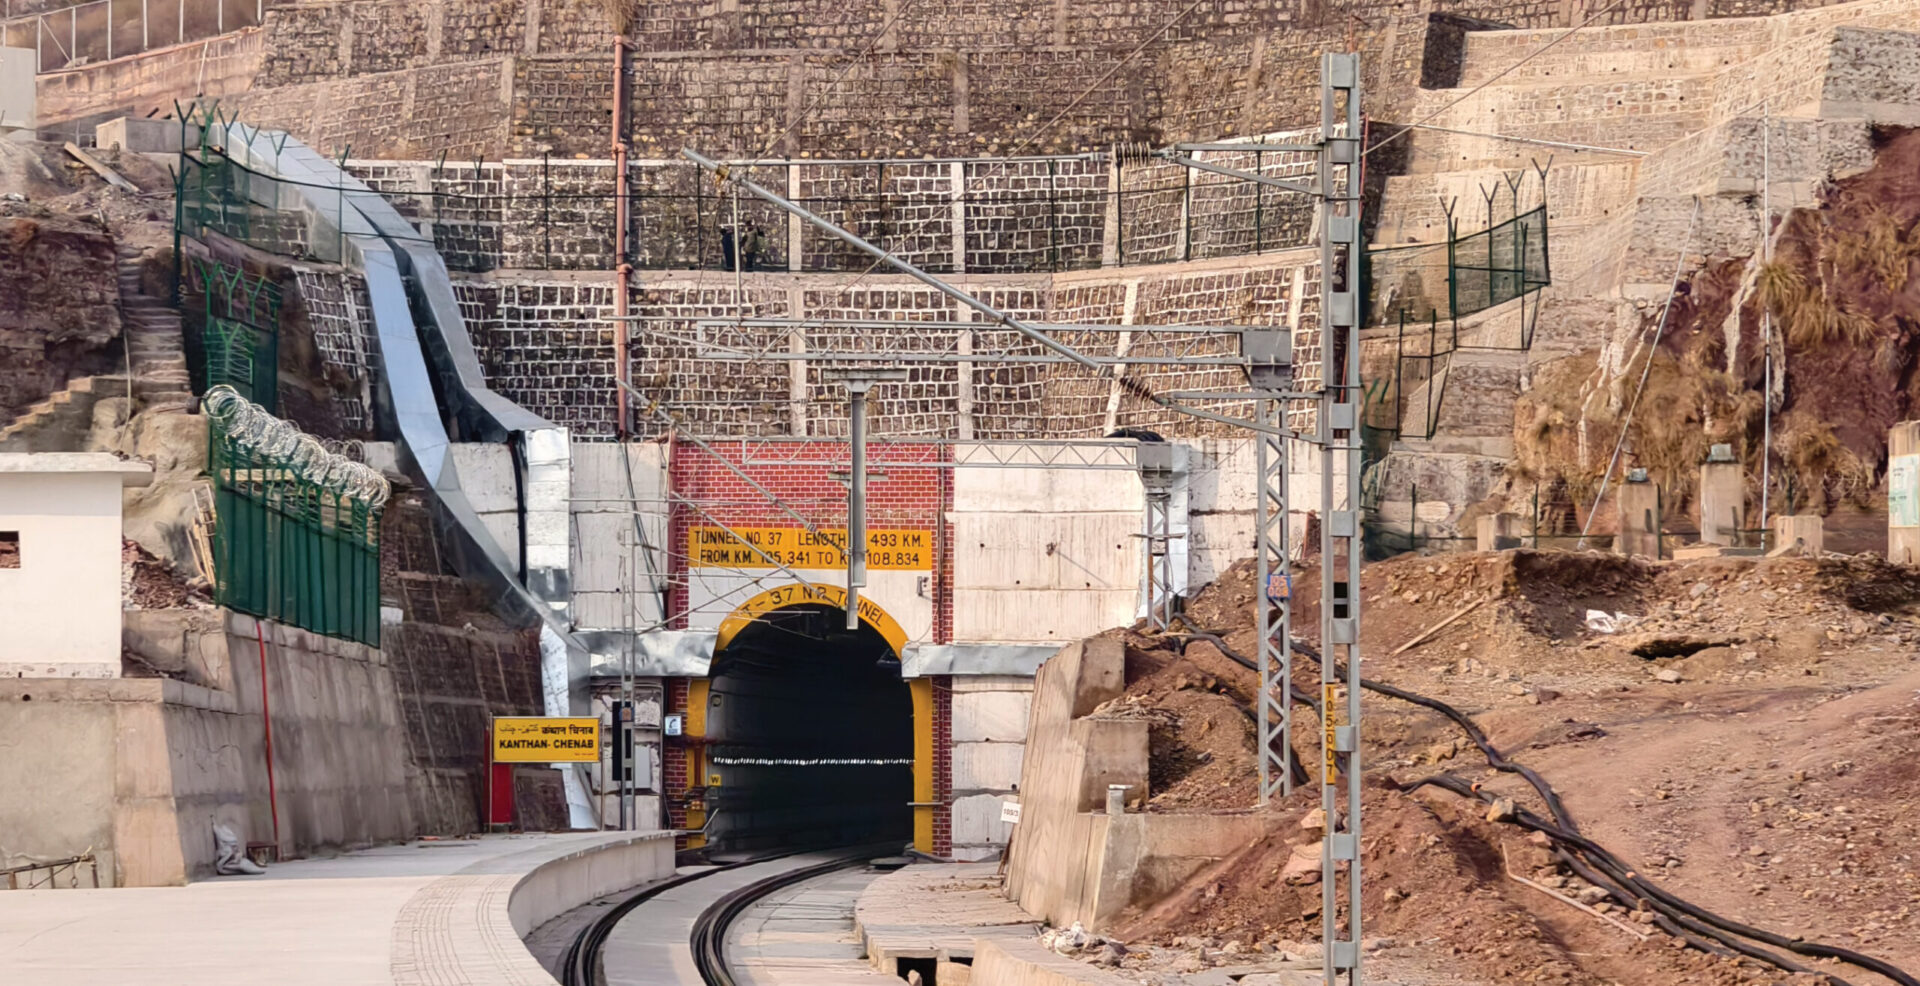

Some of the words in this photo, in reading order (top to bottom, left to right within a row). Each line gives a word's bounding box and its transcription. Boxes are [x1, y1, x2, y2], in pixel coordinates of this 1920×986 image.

[694, 531, 740, 545] TUNNEL
[768, 532, 782, 545] 37
[798, 532, 846, 546] LENGTH
[903, 534, 924, 548] KM.
[700, 549, 729, 563] FROM
[734, 550, 755, 564] KM.
[816, 551, 833, 565] TO
[867, 552, 919, 566] 108.834
[836, 590, 884, 627] TNEL
[553, 739, 594, 749] CHENAB
